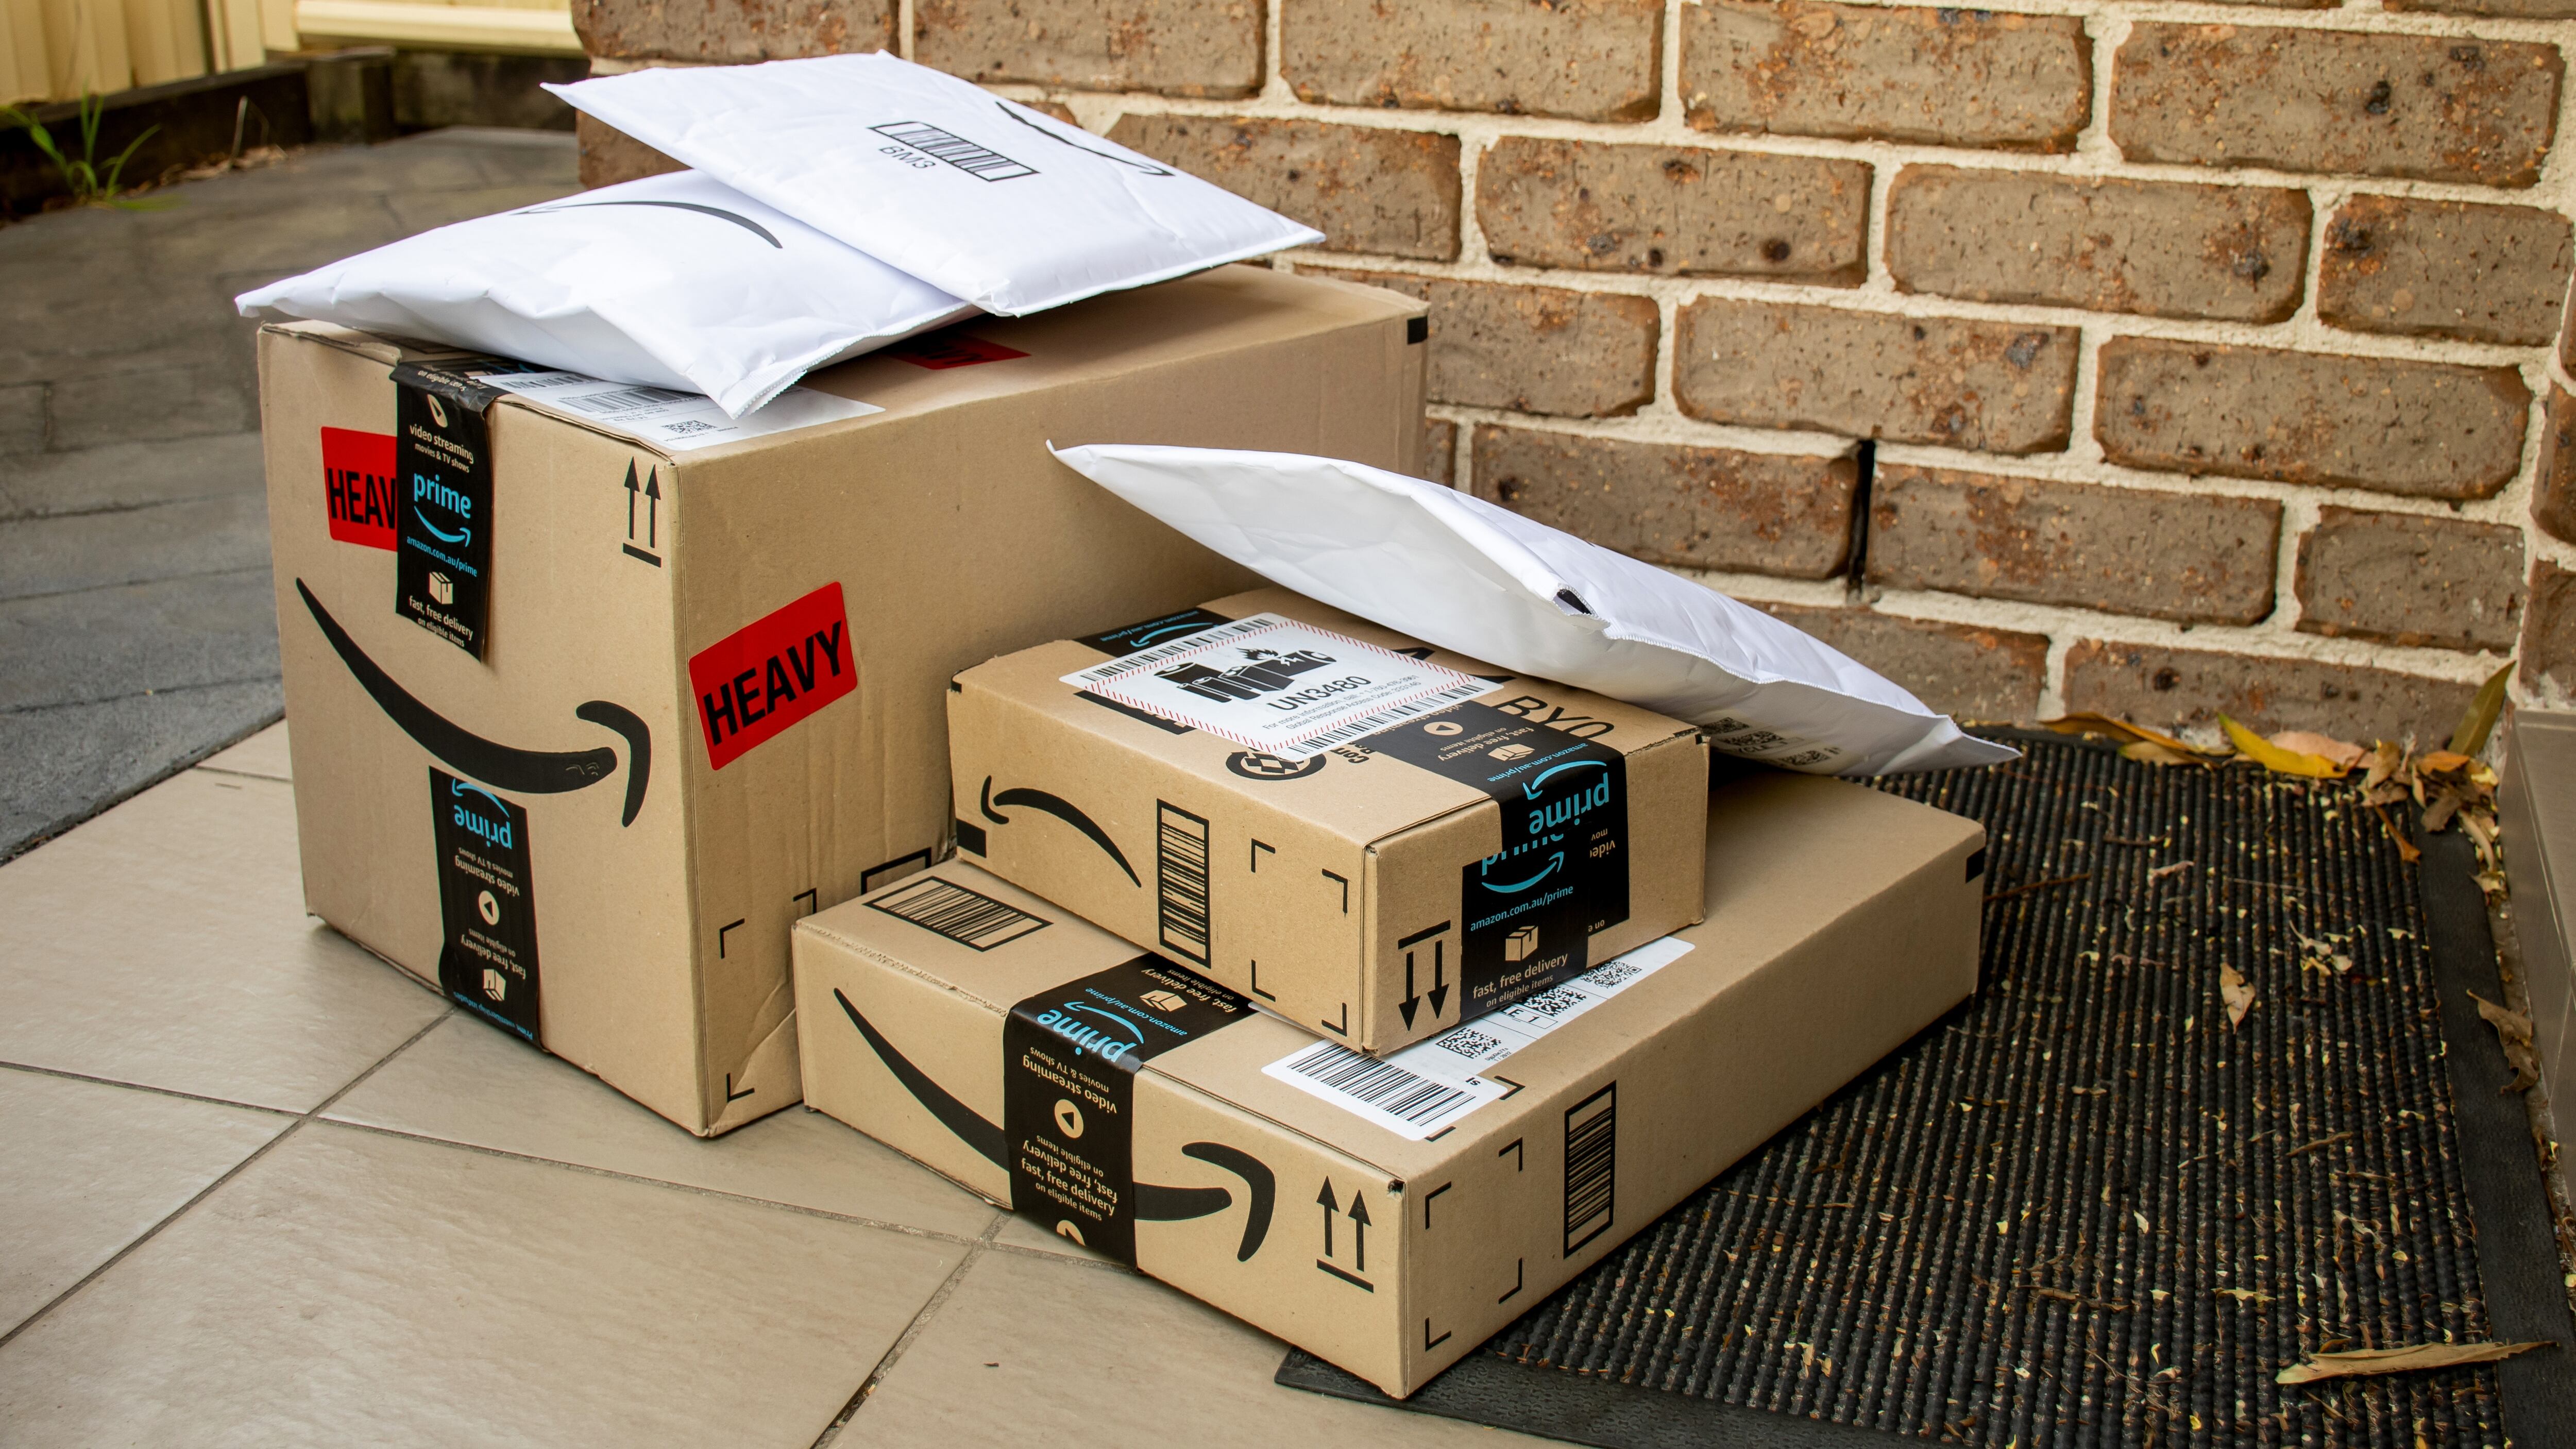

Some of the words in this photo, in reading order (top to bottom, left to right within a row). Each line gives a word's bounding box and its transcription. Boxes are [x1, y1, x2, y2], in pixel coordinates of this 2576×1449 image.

[878, 145, 936, 170] BM3
[409, 424, 433, 443] video
[433, 435, 474, 464] streaming
[415, 443, 435, 458] movies
[436, 451, 442, 460] &
[442, 453, 451, 464] TV
[451, 459, 470, 473] shows
[327, 467, 396, 530] HEAV
[414, 473, 471, 519] prime
[406, 536, 478, 577] amazon.com.au/prime
[409, 595, 425, 615] fast,
[427, 604, 442, 622] free
[443, 614, 473, 641] delivery
[418, 617, 426, 627] on
[427, 622, 448, 638] eligible
[449, 631, 465, 647] items
[702, 619, 843, 747] HEAVY
[1266, 676, 1371, 711] UN3480
[1279, 715, 1300, 724] more
[1286, 718, 1313, 730] Global
[1310, 705, 1348, 720] Response
[1465, 730, 1495, 744] eligible
[1487, 734, 1510, 746] free
[1505, 726, 1534, 737] fast,
[1437, 743, 1485, 762] delivery
[1440, 739, 1466, 751] items
[1487, 742, 1588, 782] amazon.com.au/prime
[1529, 772, 1609, 835] prime
[454, 804, 513, 850] prime
[1591, 828, 1608, 841] mov
[459, 847, 476, 862] shows
[1589, 840, 1616, 858] vide
[455, 854, 495, 885] streaming
[478, 856, 486, 867] TV
[492, 863, 513, 878] movies
[497, 877, 520, 897] video
[1470, 885, 1573, 932] amazon.com.au/prime
[468, 928, 485, 943] items
[486, 936, 507, 953] eligible
[461, 934, 492, 960] delivery
[508, 948, 516, 957] on
[493, 952, 509, 970] free
[510, 959, 526, 980] fast,
[1141, 968, 1187, 989] delivery
[1167, 969, 1192, 981] items
[1472, 983, 1497, 999] fast,
[1500, 972, 1521, 988] free
[1524, 953, 1568, 979] delivery
[1186, 988, 1211, 1001] free
[1190, 979, 1223, 995] eligible
[1486, 998, 1497, 1007] on
[1499, 984, 1530, 1002] eligible
[1531, 974, 1554, 989] items
[1085, 987, 1188, 1036] amazon.com.au/prime
[1212, 998, 1237, 1013] fast,
[1037, 1008, 1138, 1063] prime
[1030, 1047, 1055, 1066] shows
[1023, 1054, 1081, 1094] streaming
[1057, 1062, 1068, 1074] TV
[1070, 1068, 1077, 1079] &
[1079, 1072, 1109, 1093] movies
[1084, 1089, 1117, 1114] video
[1023, 1139, 1067, 1173] delivery
[1037, 1135, 1059, 1155] items
[1060, 1148, 1091, 1170] eligible
[1069, 1166, 1091, 1188] free
[1093, 1166, 1104, 1177] on
[1021, 1157, 1044, 1181] fast,
[1046, 1170, 1069, 1191] free
[1071, 1184, 1115, 1217] delivery
[1094, 1178, 1117, 1204] fast,
[1036, 1182, 1046, 1193] on
[1047, 1188, 1077, 1209] eligible
[1079, 1202, 1102, 1221] items
